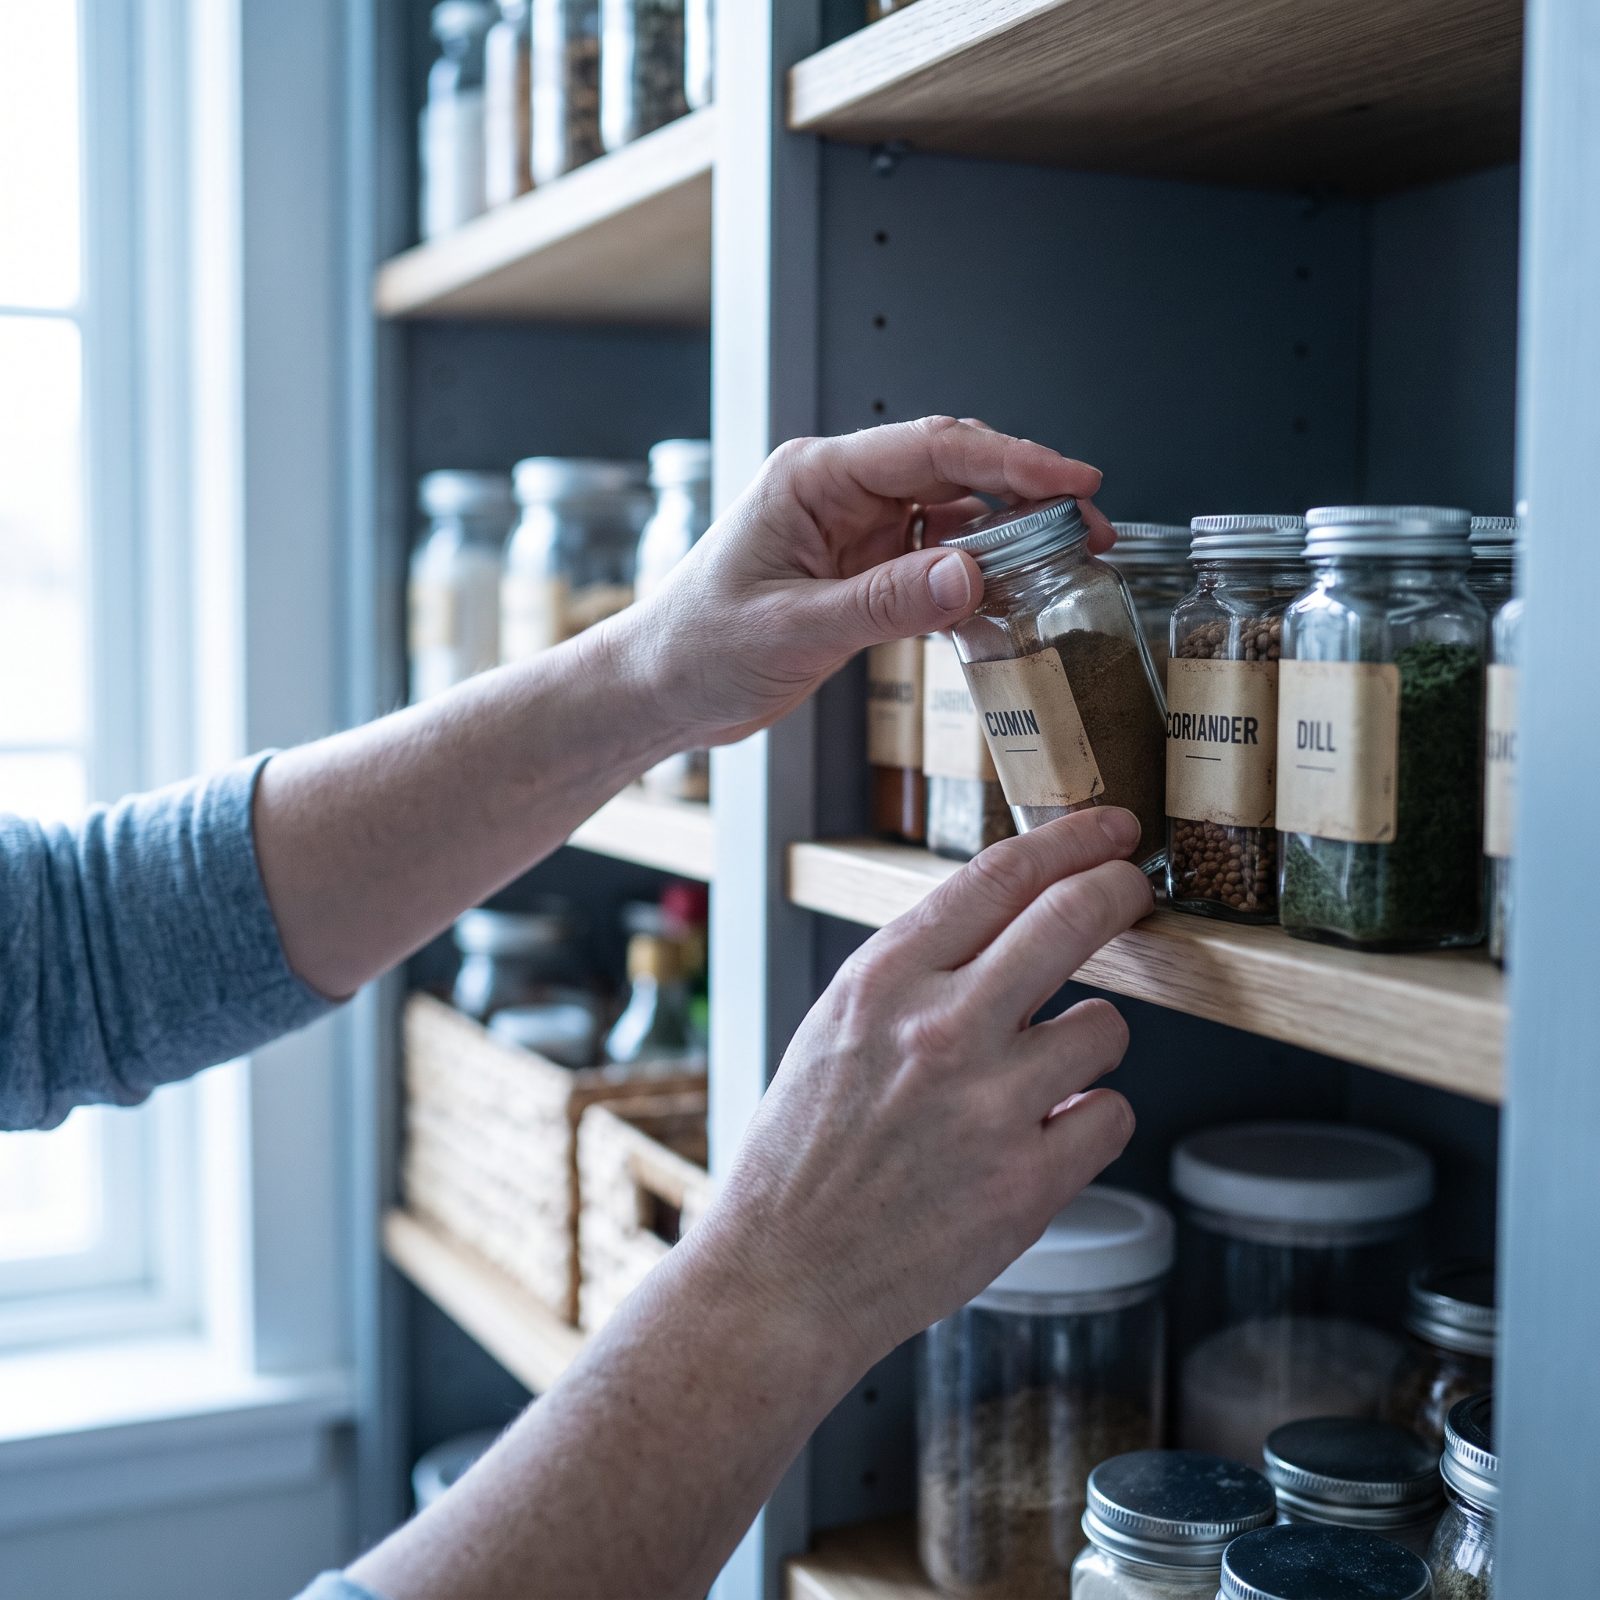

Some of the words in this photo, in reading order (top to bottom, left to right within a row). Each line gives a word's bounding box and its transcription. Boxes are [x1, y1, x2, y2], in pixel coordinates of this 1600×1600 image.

[985, 709, 1040, 737] CUMIN
[1166, 711, 1258, 744] CORIANDER
[1297, 720, 1336, 752] DILL
